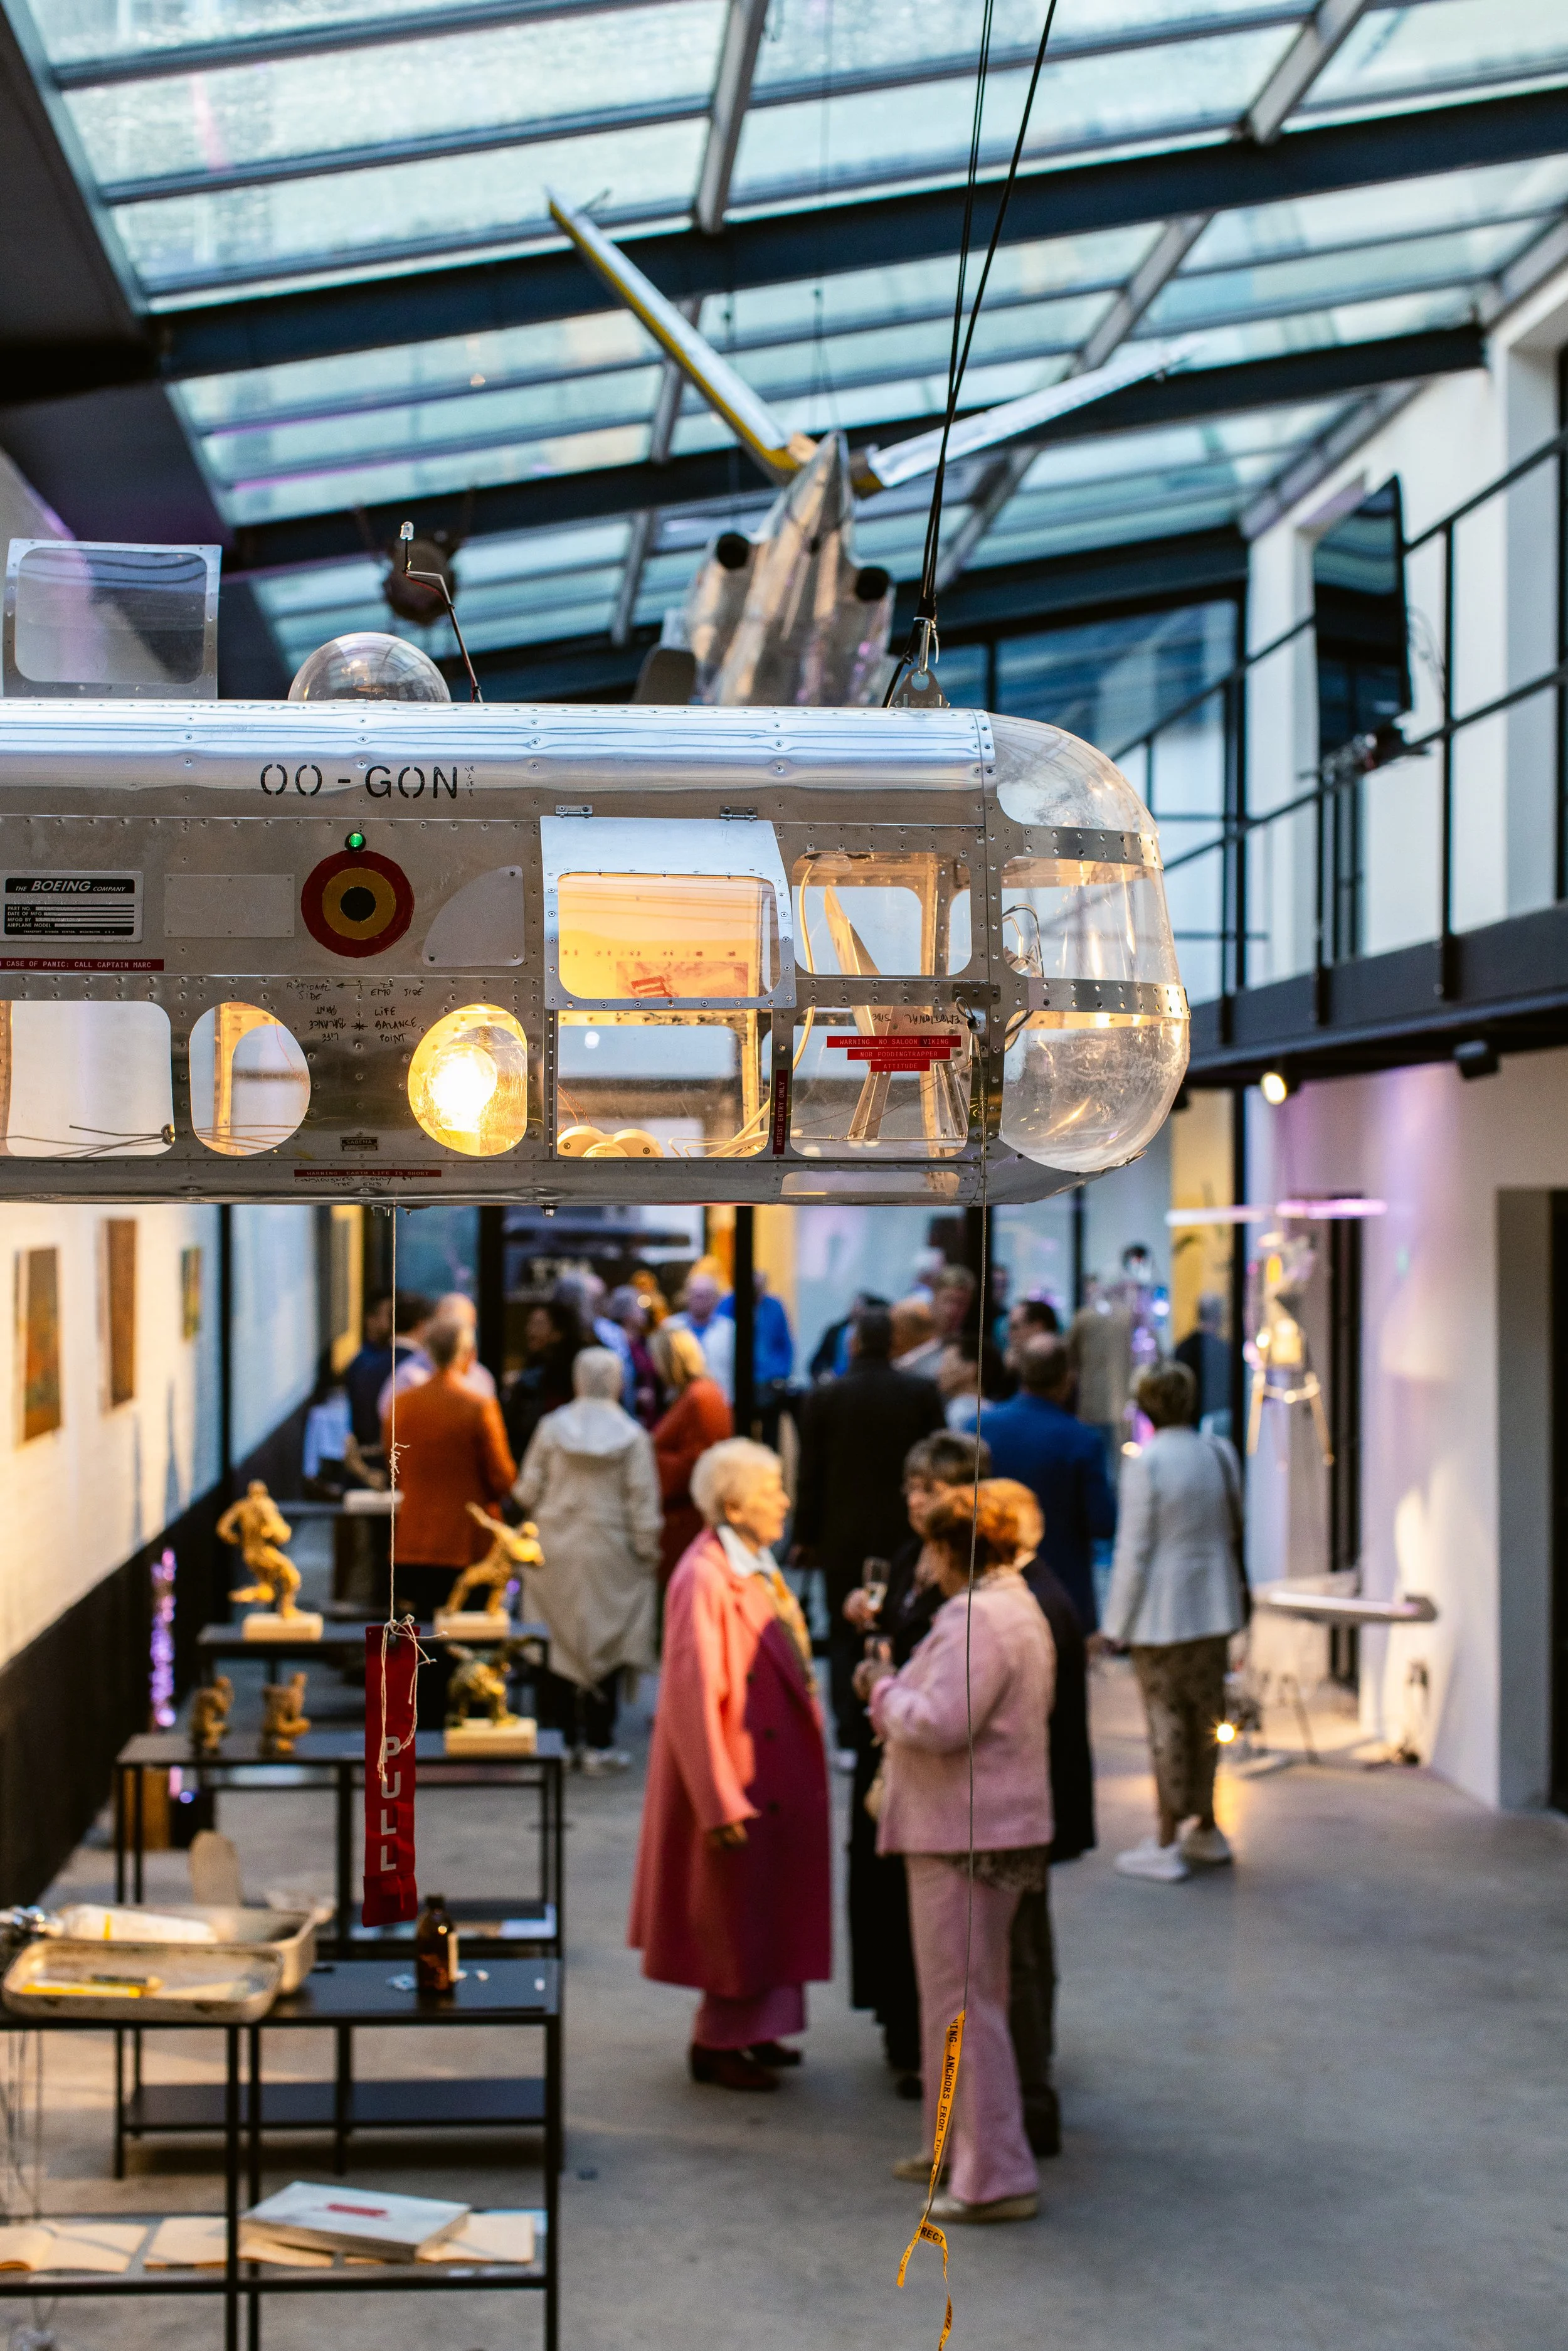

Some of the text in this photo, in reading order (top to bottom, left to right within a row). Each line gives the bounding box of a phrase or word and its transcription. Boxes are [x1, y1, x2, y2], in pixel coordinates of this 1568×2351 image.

[31, 881, 91, 892] BOEING
[286, 982, 331, 991] RATIONAL
[371, 987, 424, 996] EMO SIDE
[299, 991, 322, 1000] SIDE
[374, 1006, 396, 1016] LIFE
[309, 1017, 346, 1030] BALANCE
[375, 1017, 417, 1030] BALANCE
[872, 1013, 961, 1025] EMOTIONAL SIDE
[379, 1033, 406, 1044] POINT
[381, 1736, 401, 1872] PULL
[943, 2054, 955, 2099] ANCHORS
[938, 2106, 947, 2131] FROM
